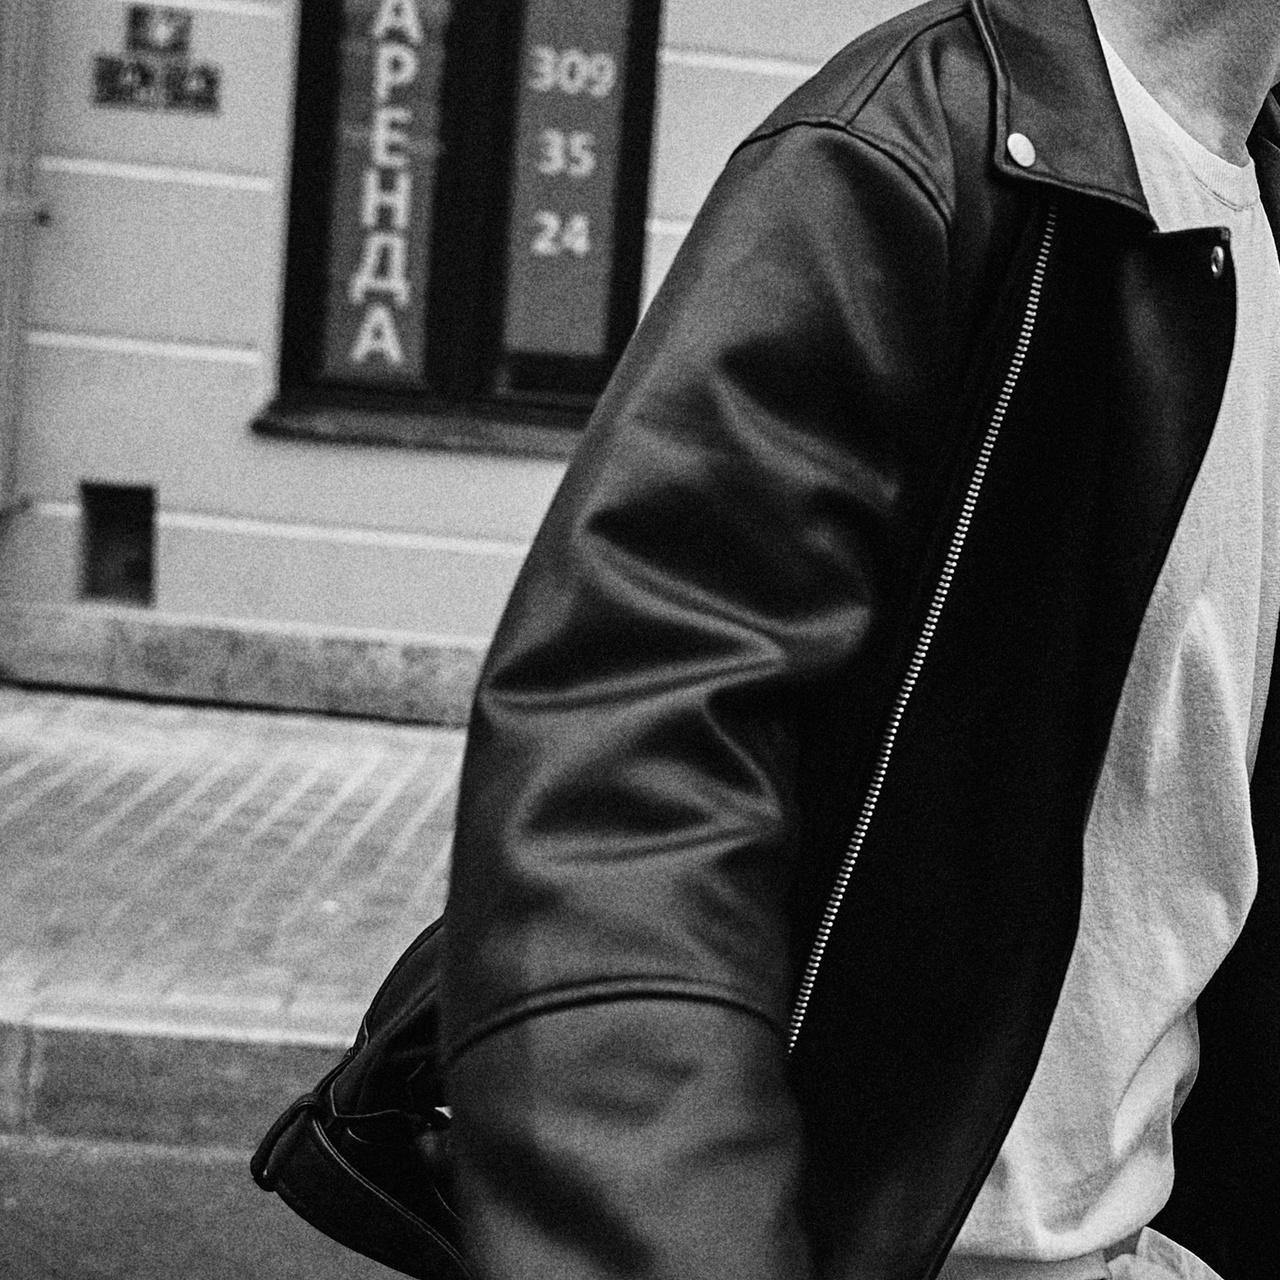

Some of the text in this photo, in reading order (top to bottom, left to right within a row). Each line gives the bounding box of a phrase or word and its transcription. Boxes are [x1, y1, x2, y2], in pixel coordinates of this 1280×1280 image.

[528, 45, 617, 98] 309
[538, 129, 597, 177] 35
[531, 210, 591, 257] 24
